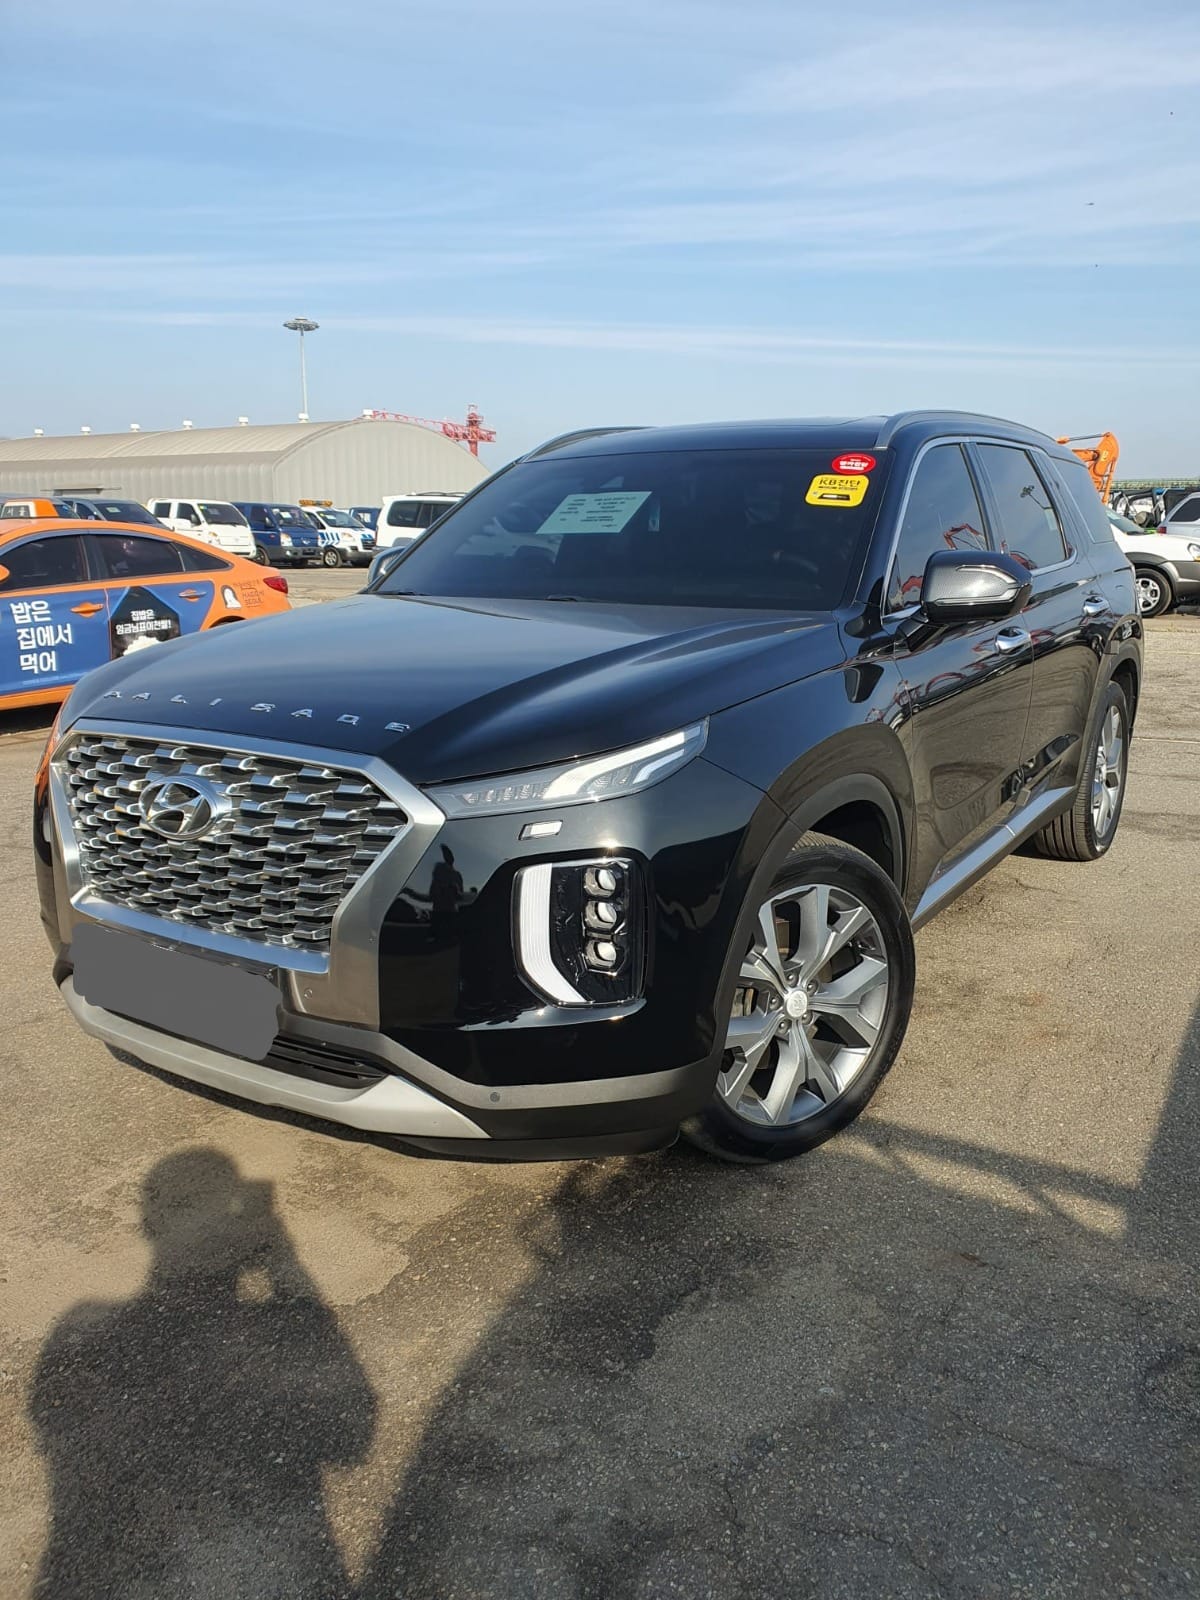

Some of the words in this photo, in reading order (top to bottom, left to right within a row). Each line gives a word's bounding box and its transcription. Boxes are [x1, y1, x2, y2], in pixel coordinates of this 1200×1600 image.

[9, 600, 52, 624] 밥은
[16, 623, 73, 650] 집에서
[20, 650, 57, 674] 먹어
